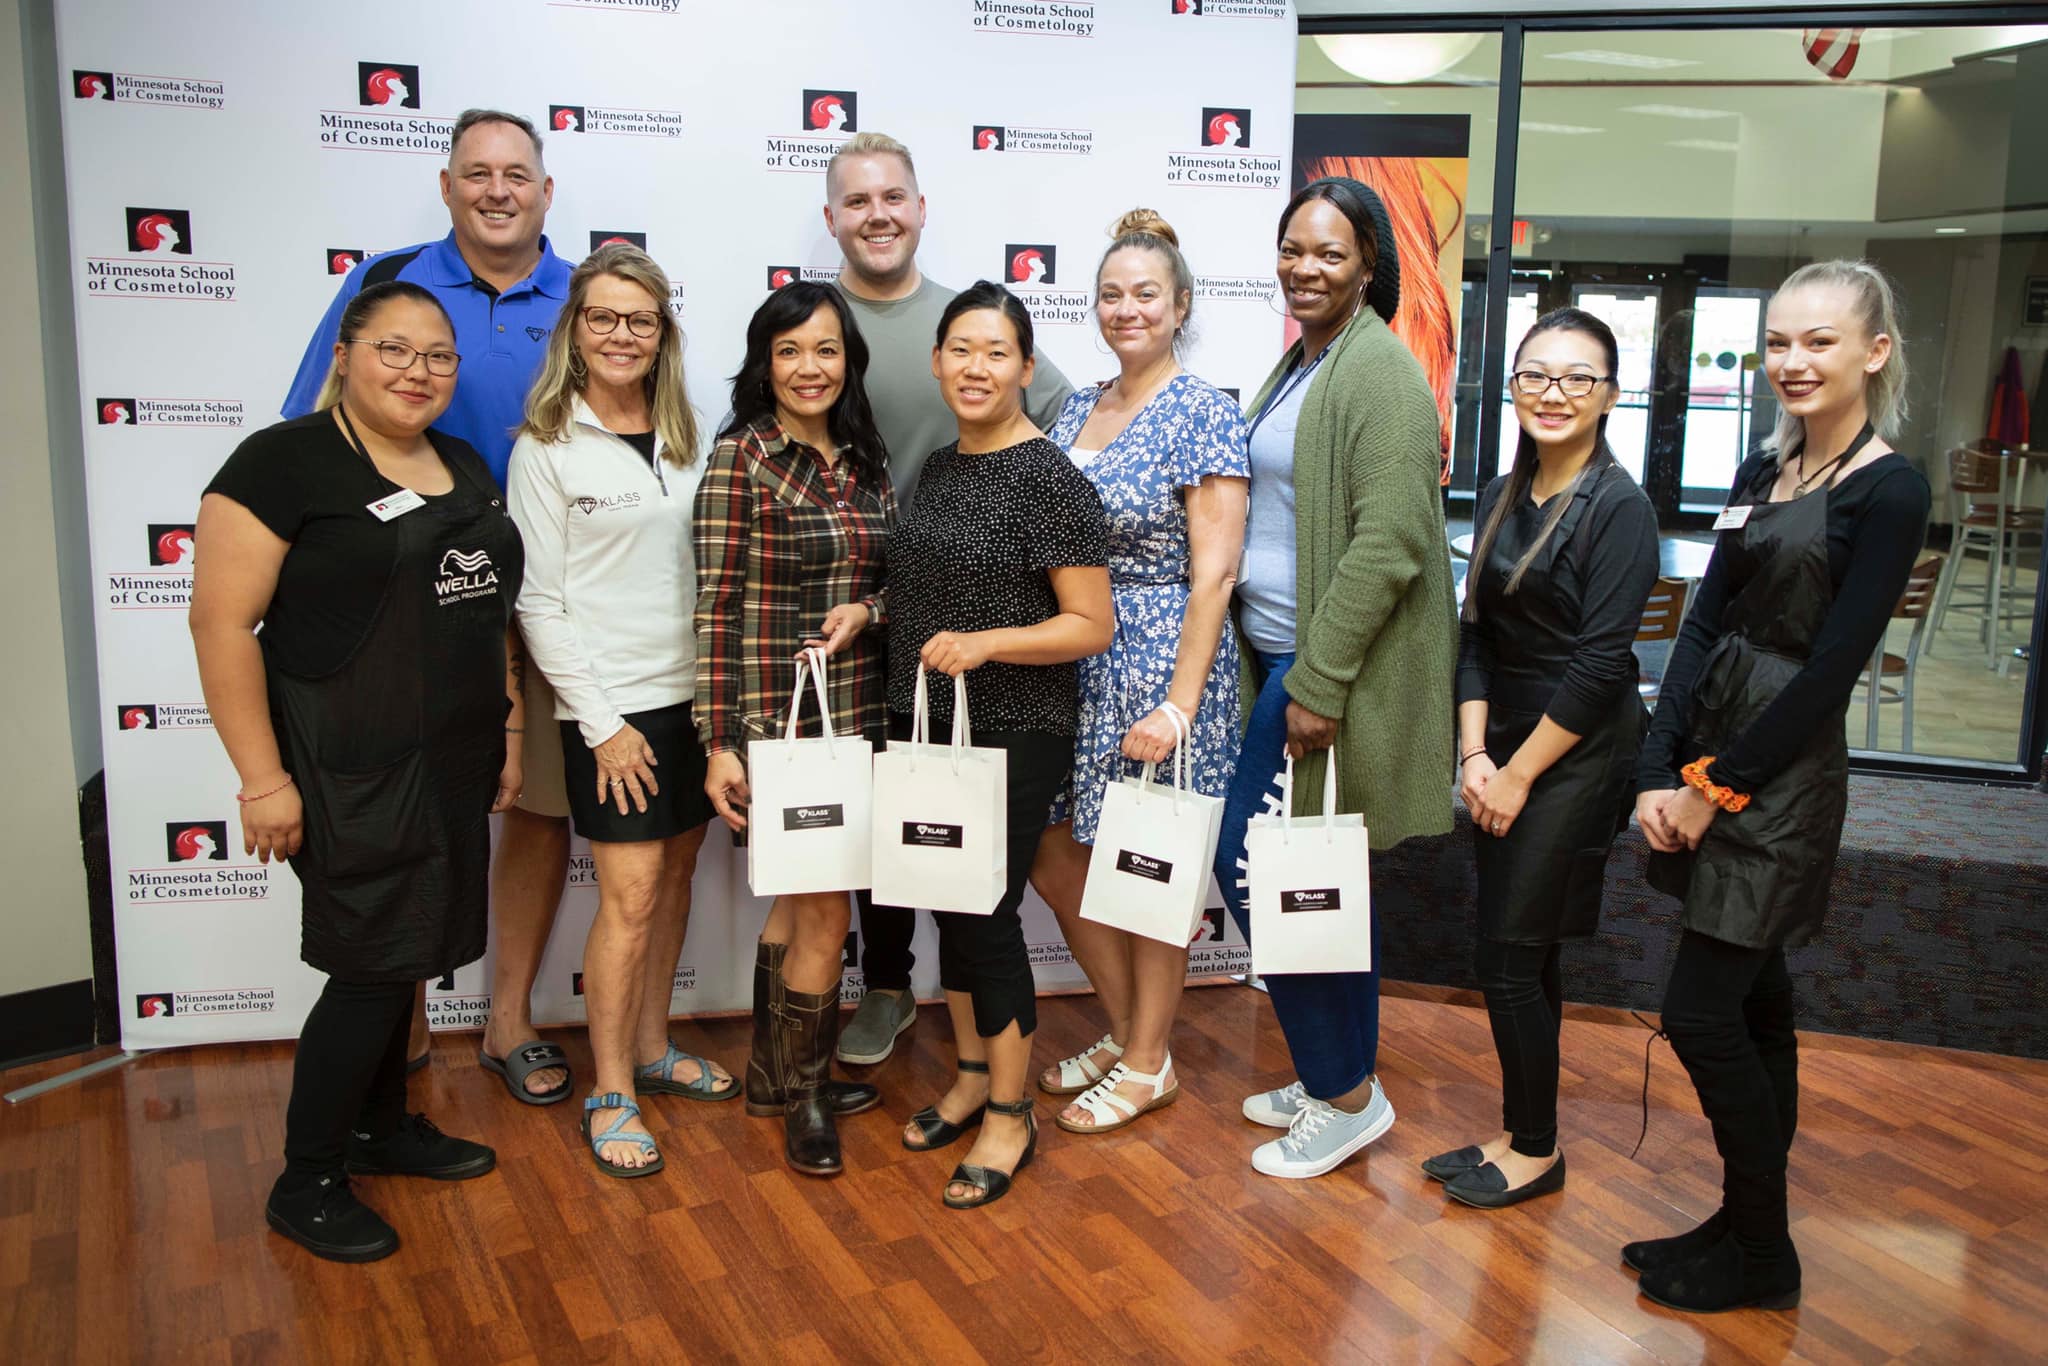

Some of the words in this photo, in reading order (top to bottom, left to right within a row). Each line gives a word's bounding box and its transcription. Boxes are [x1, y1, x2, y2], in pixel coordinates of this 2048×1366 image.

[974, 0, 1045, 15] Minnesota
[1049, 4, 1094, 18] School
[1204, 4, 1215, 12] of
[1218, 5, 1286, 17] Cosmetology
[974, 14, 989, 26] of
[995, 15, 1094, 35] Cosmetology
[116, 76, 180, 91] Minnesota
[184, 81, 224, 94] School
[117, 88, 130, 98] of
[136, 89, 224, 108] Cosmetology
[587, 110, 643, 122] Minnesota
[646, 113, 681, 124] School
[320, 114, 403, 132] Minnesota
[408, 120, 454, 135] Schoo
[587, 120, 599, 129] of
[603, 121, 682, 136] Cosmetology
[321, 130, 338, 143] of
[346, 131, 450, 153] Cosmetolog
[1007, 129, 1058, 140] Minnesota
[1060, 131, 1092, 141] School
[1006, 140, 1018, 148] of
[1021, 140, 1092, 153] Cosmetology
[767, 154, 782, 166] of
[1168, 155, 1235, 169] Minnesota
[1239, 158, 1281, 171] School
[1167, 169, 1182, 180] of
[1187, 169, 1281, 187] Cosmetology
[88, 262, 175, 278] Minnesota
[180, 266, 234, 280] School
[803, 269, 840, 279] Minnes
[88, 277, 106, 290] of
[114, 278, 235, 299] Cosmetology
[1196, 278, 1243, 288] Minnesota
[1246, 280, 1276, 289] School
[1195, 288, 1206, 296] of
[1044, 294, 1088, 306] School
[1033, 307, 1087, 323] etology
[139, 401, 201, 412] Minnesota
[204, 402, 243, 412] School
[139, 412, 152, 421] of
[158, 412, 243, 425] Cosmetology
[599, 491, 640, 507] KLASS
[110, 577, 194, 589] Minnesota
[434, 571, 498, 595] WELLA
[110, 591, 128, 604] of
[439, 595, 460, 606] SCHOOL
[462, 587, 497, 599] PROGRAMS
[159, 706, 209, 715] Minneso
[159, 716, 172, 726] of
[129, 872, 212, 886] Minnesota
[217, 869, 268, 882] School
[570, 870, 586, 882] of
[129, 887, 147, 899] of
[154, 883, 269, 898] Cosmetology
[1046, 944, 1068, 953] Scho
[1188, 961, 1252, 973] metology
[176, 993, 234, 1003] Minnesota
[237, 990, 274, 1000] School
[176, 1003, 189, 1013] of
[193, 1001, 275, 1012] Cosmetology
[443, 998, 490, 1011] School
[432, 1012, 490, 1026] etology
